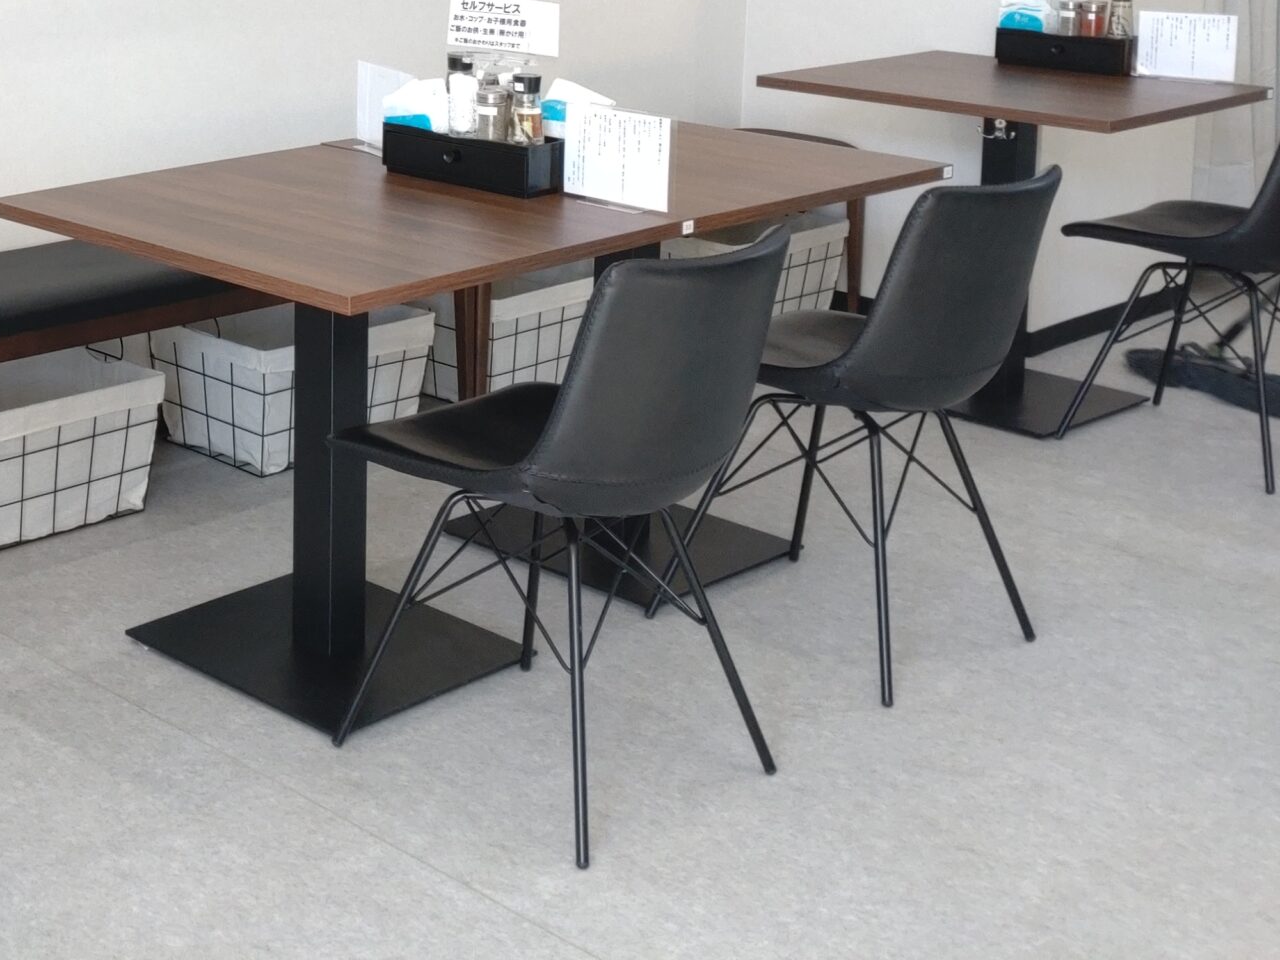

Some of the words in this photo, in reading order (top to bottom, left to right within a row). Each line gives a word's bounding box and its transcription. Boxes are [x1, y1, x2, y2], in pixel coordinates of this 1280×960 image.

[461, 0, 521, 14] セルフサービス
